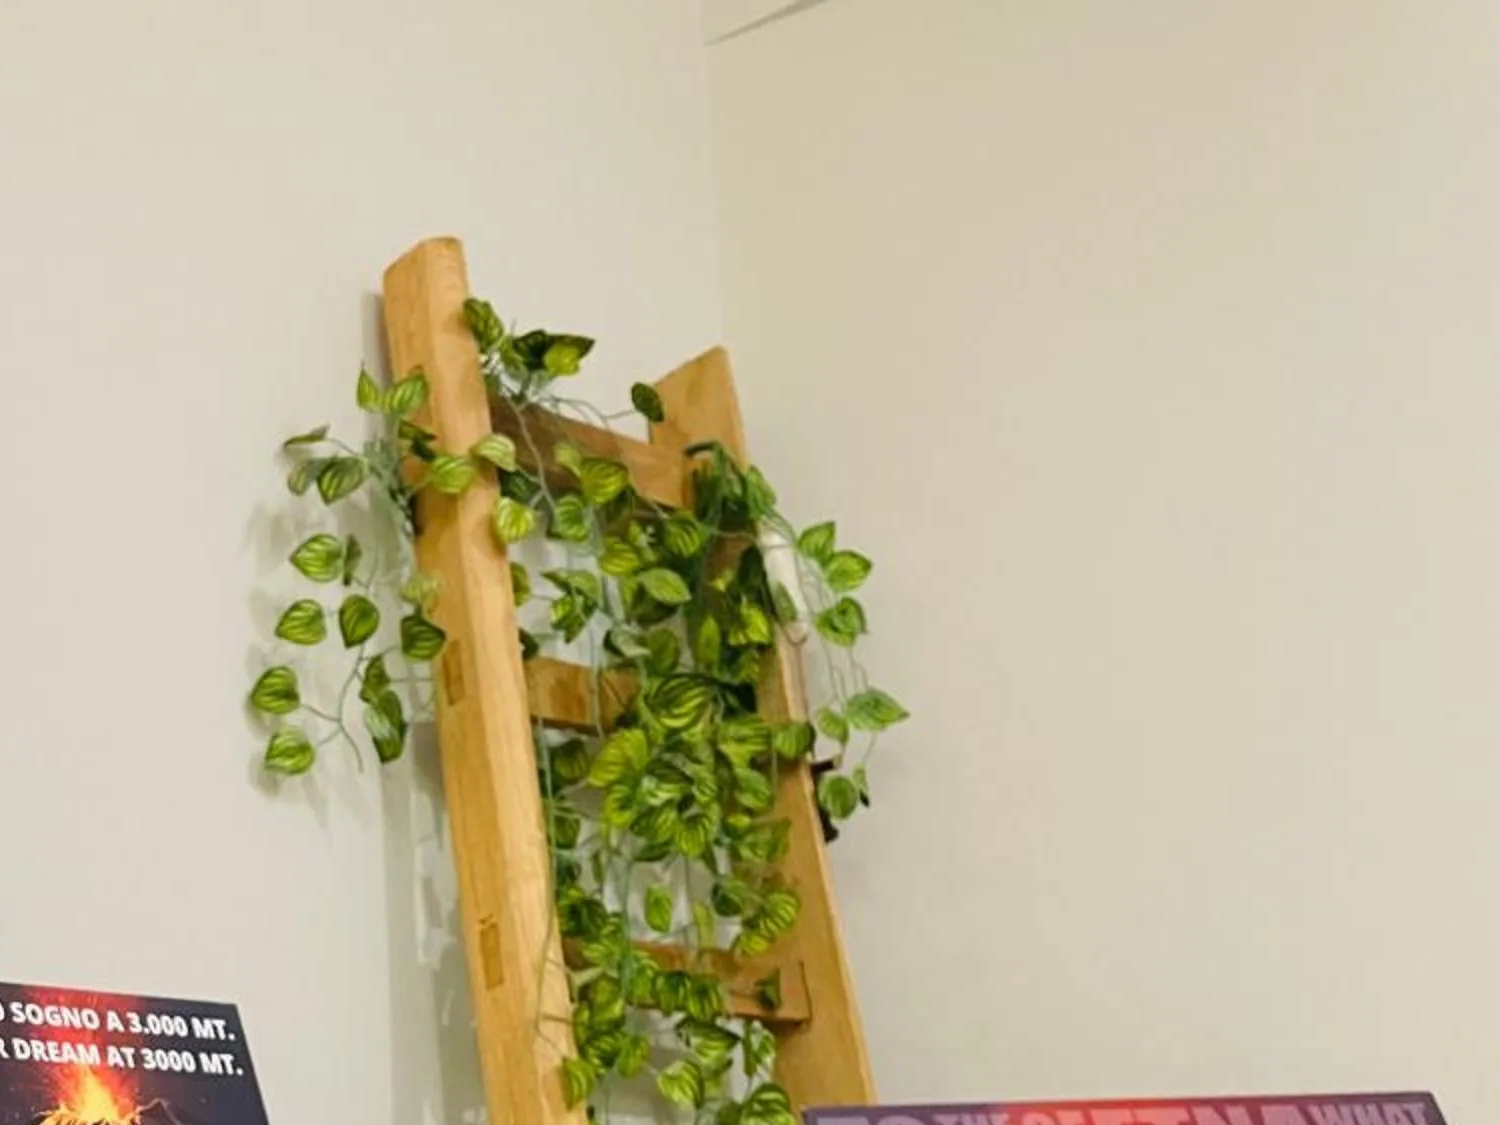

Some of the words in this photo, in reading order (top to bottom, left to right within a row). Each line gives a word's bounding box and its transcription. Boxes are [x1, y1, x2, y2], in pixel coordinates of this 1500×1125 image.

[10, 1001, 100, 1031] SOGNO
[106, 1011, 126, 1034] A
[129, 1013, 188, 1038] 3.000
[194, 1018, 236, 1042] MT.
[13, 1038, 100, 1067] DREAM
[106, 1044, 137, 1070] AT
[142, 1048, 197, 1074] 3000
[199, 1052, 245, 1077] MT.
